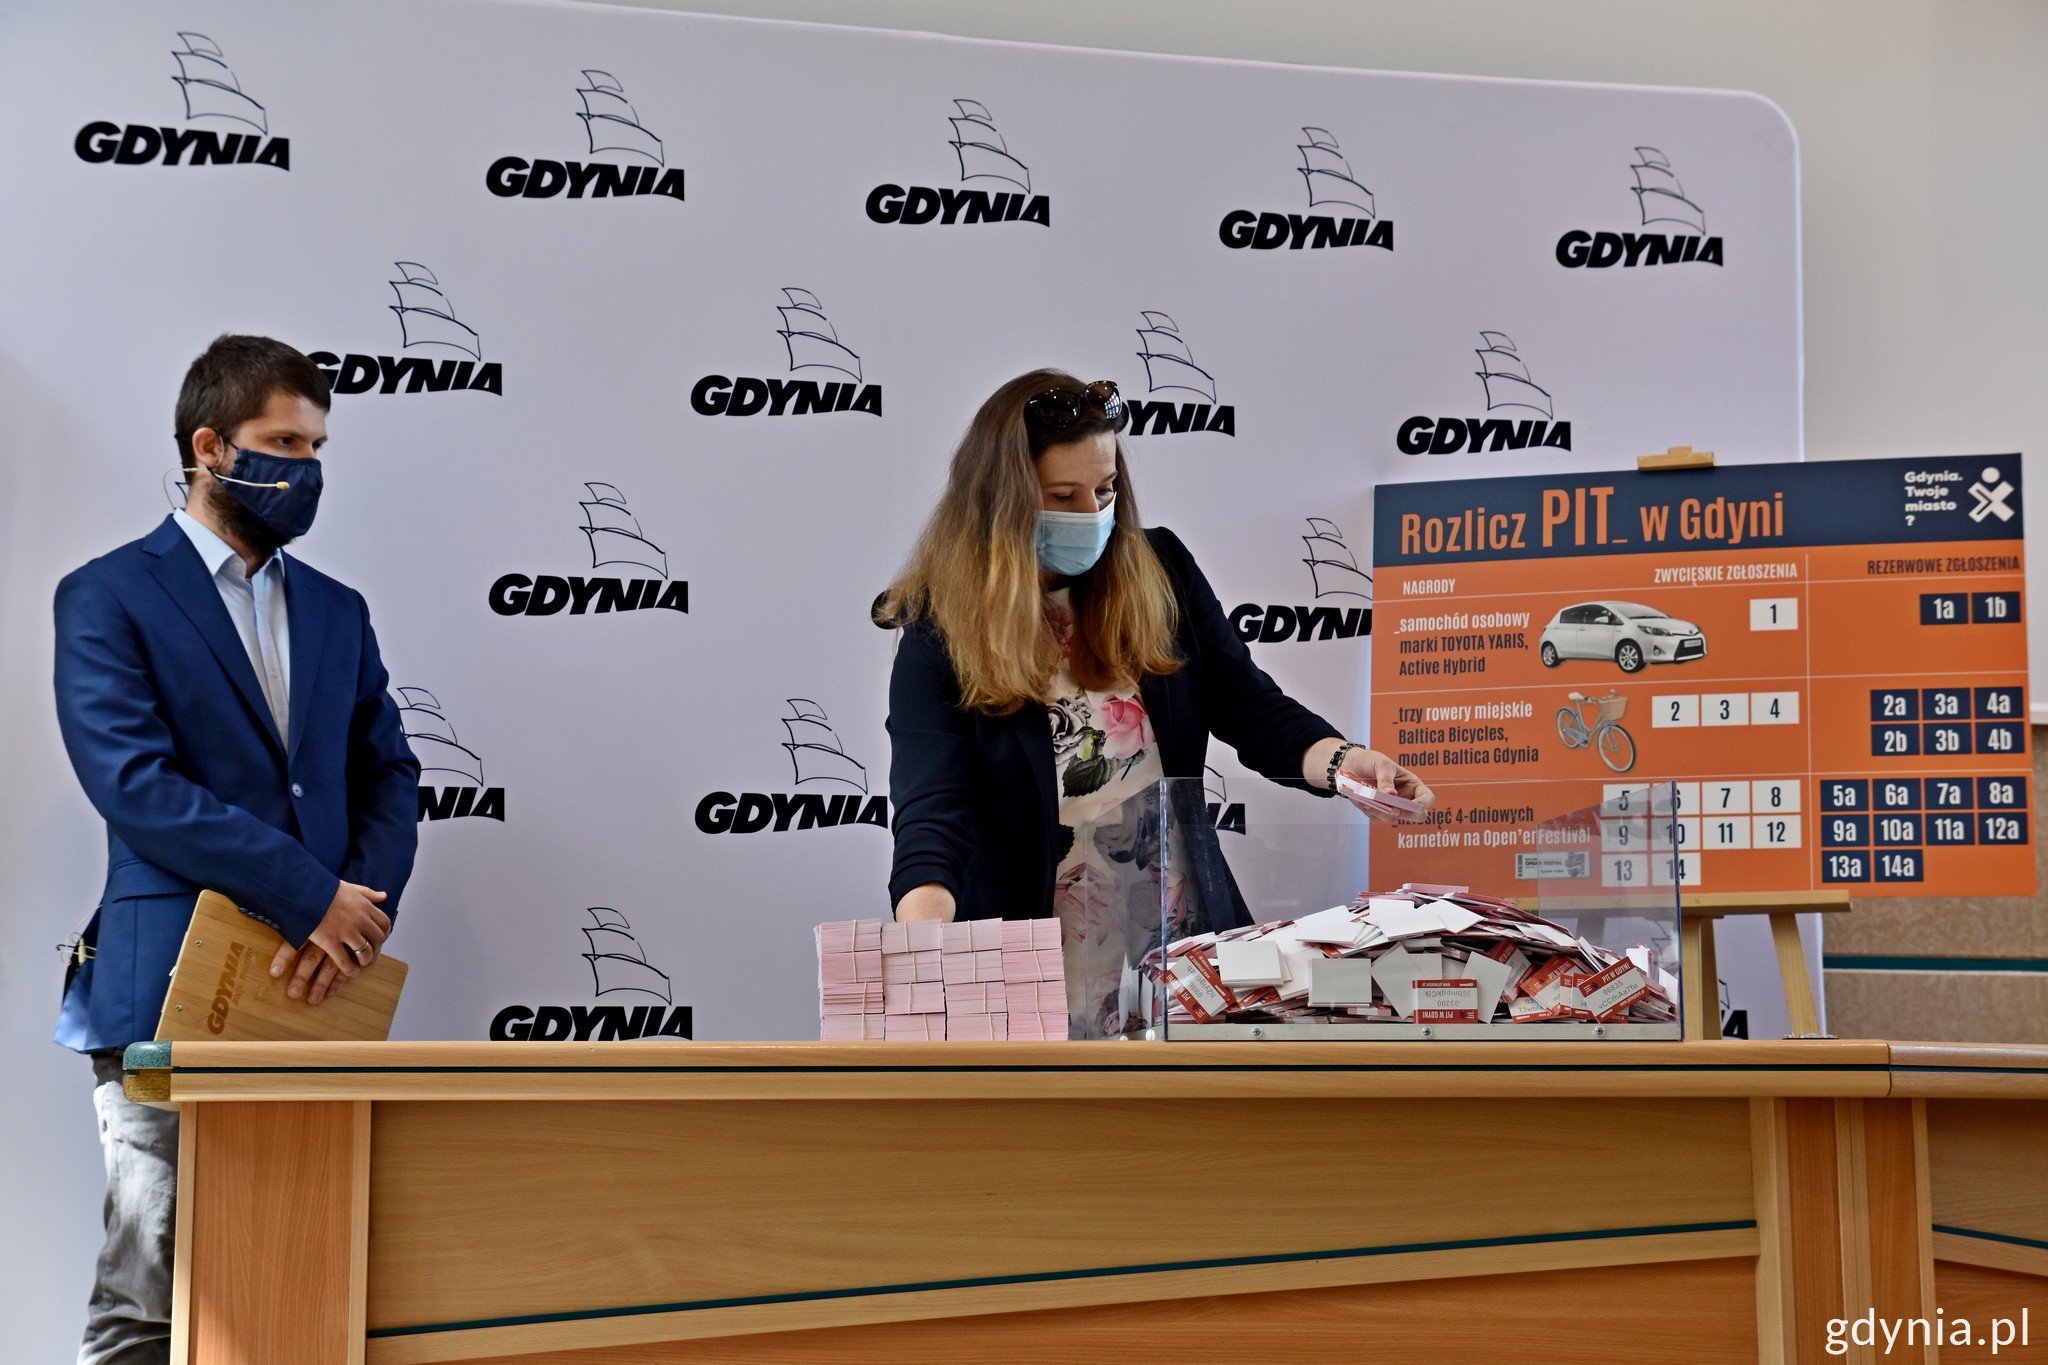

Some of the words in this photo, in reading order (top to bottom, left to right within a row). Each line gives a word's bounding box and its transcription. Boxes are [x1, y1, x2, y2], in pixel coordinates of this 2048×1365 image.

[75, 122, 289, 170] GDYNIA
[486, 157, 684, 201] GDYNIA
[866, 184, 1049, 227] GDYNIA
[1219, 210, 1393, 251] GDYNIA
[1556, 230, 1723, 268] GDYNIA
[691, 375, 882, 417] GDYNIA
[1120, 399, 1236, 437] YNIA
[1397, 416, 1571, 455] GDYNIA
[1904, 470, 1964, 484] Gdynia.
[1904, 485, 1949, 498] Twoje
[1904, 500, 1957, 512] miasto
[1401, 506, 1527, 555] Rozlicz
[1640, 505, 1669, 542] w
[1680, 492, 1784, 545] Gdyni
[1904, 514, 1915, 526] ?
[1654, 565, 1724, 586] ZWYCIĘSKIE
[1726, 563, 1798, 581] ZGŁOSZENIA
[1867, 558, 1943, 575] REZERWOWE
[1945, 556, 2020, 573] ZGŁOSZENIA
[489, 574, 688, 615] GDYNIA
[1402, 579, 1456, 595] NAGRODY
[1769, 604, 1778, 625] 1
[1933, 598, 1955, 619] 1a
[1985, 597, 2008, 618] 1b
[1228, 603, 1373, 643] GDYNI
[1472, 611, 1530, 629] osobowy
[1400, 636, 1438, 654] marki
[1441, 635, 1485, 651] TOYOTA
[1487, 633, 1529, 652] YARIS,
[1399, 658, 1440, 676] Active
[1443, 657, 1486, 677] Hybrid
[1426, 704, 1472, 722] rowery
[1474, 701, 1533, 721] miejskie
[1671, 700, 1681, 722] 2
[1719, 699, 1730, 720] 3
[1769, 698, 1781, 719] 4
[1883, 695, 1907, 716] 2a
[1934, 694, 1958, 715] 3a
[1986, 692, 2011, 714] 4a
[1398, 728, 1445, 746] Baltica
[1448, 725, 1509, 744] Bicycles,
[1884, 731, 1908, 752] 2b
[1935, 730, 1960, 751] 3b
[1987, 729, 2012, 750] 4b
[1398, 749, 1441, 767] model
[1442, 747, 1491, 766] Baltica
[1493, 746, 1539, 764] Gdynia
[417, 786, 505, 822] NIA
[1618, 790, 1630, 811] 5
[1720, 788, 1731, 808] 7
[1770, 787, 1782, 807] 8
[1832, 785, 1856, 806] 5a
[1884, 784, 1909, 805] 6a
[1936, 783, 1961, 804] 7a
[1989, 783, 2014, 804] 8a
[694, 791, 889, 834] GDYNIA
[1455, 805, 1534, 827] 4-dniowych
[1398, 830, 1461, 849] karnetów
[1463, 832, 1480, 846] na
[1538, 827, 1591, 846] Festival
[1618, 825, 1629, 846] 9
[1718, 823, 1733, 843] 11
[1767, 822, 1786, 842] 12
[1833, 820, 1857, 841] 9a
[1881, 819, 1914, 841] 10a
[1935, 819, 1965, 840] 11a
[1986, 818, 2020, 840] 12a
[1614, 859, 1633, 881] 13
[1829, 856, 1862, 877] 13a
[1882, 855, 1915, 877] 14a
[1602, 974, 1611, 983] PIT
[1615, 962, 1630, 976] GDYNI
[207, 941, 245, 1034] GDYNIA
[1603, 981, 1623, 995] 06835
[490, 1004, 692, 1041] GDYNIA
[1422, 1011, 1438, 1019] GDYNI
[1438, 1011, 1444, 1019] W
[1446, 1011, 1454, 1019] PIT
